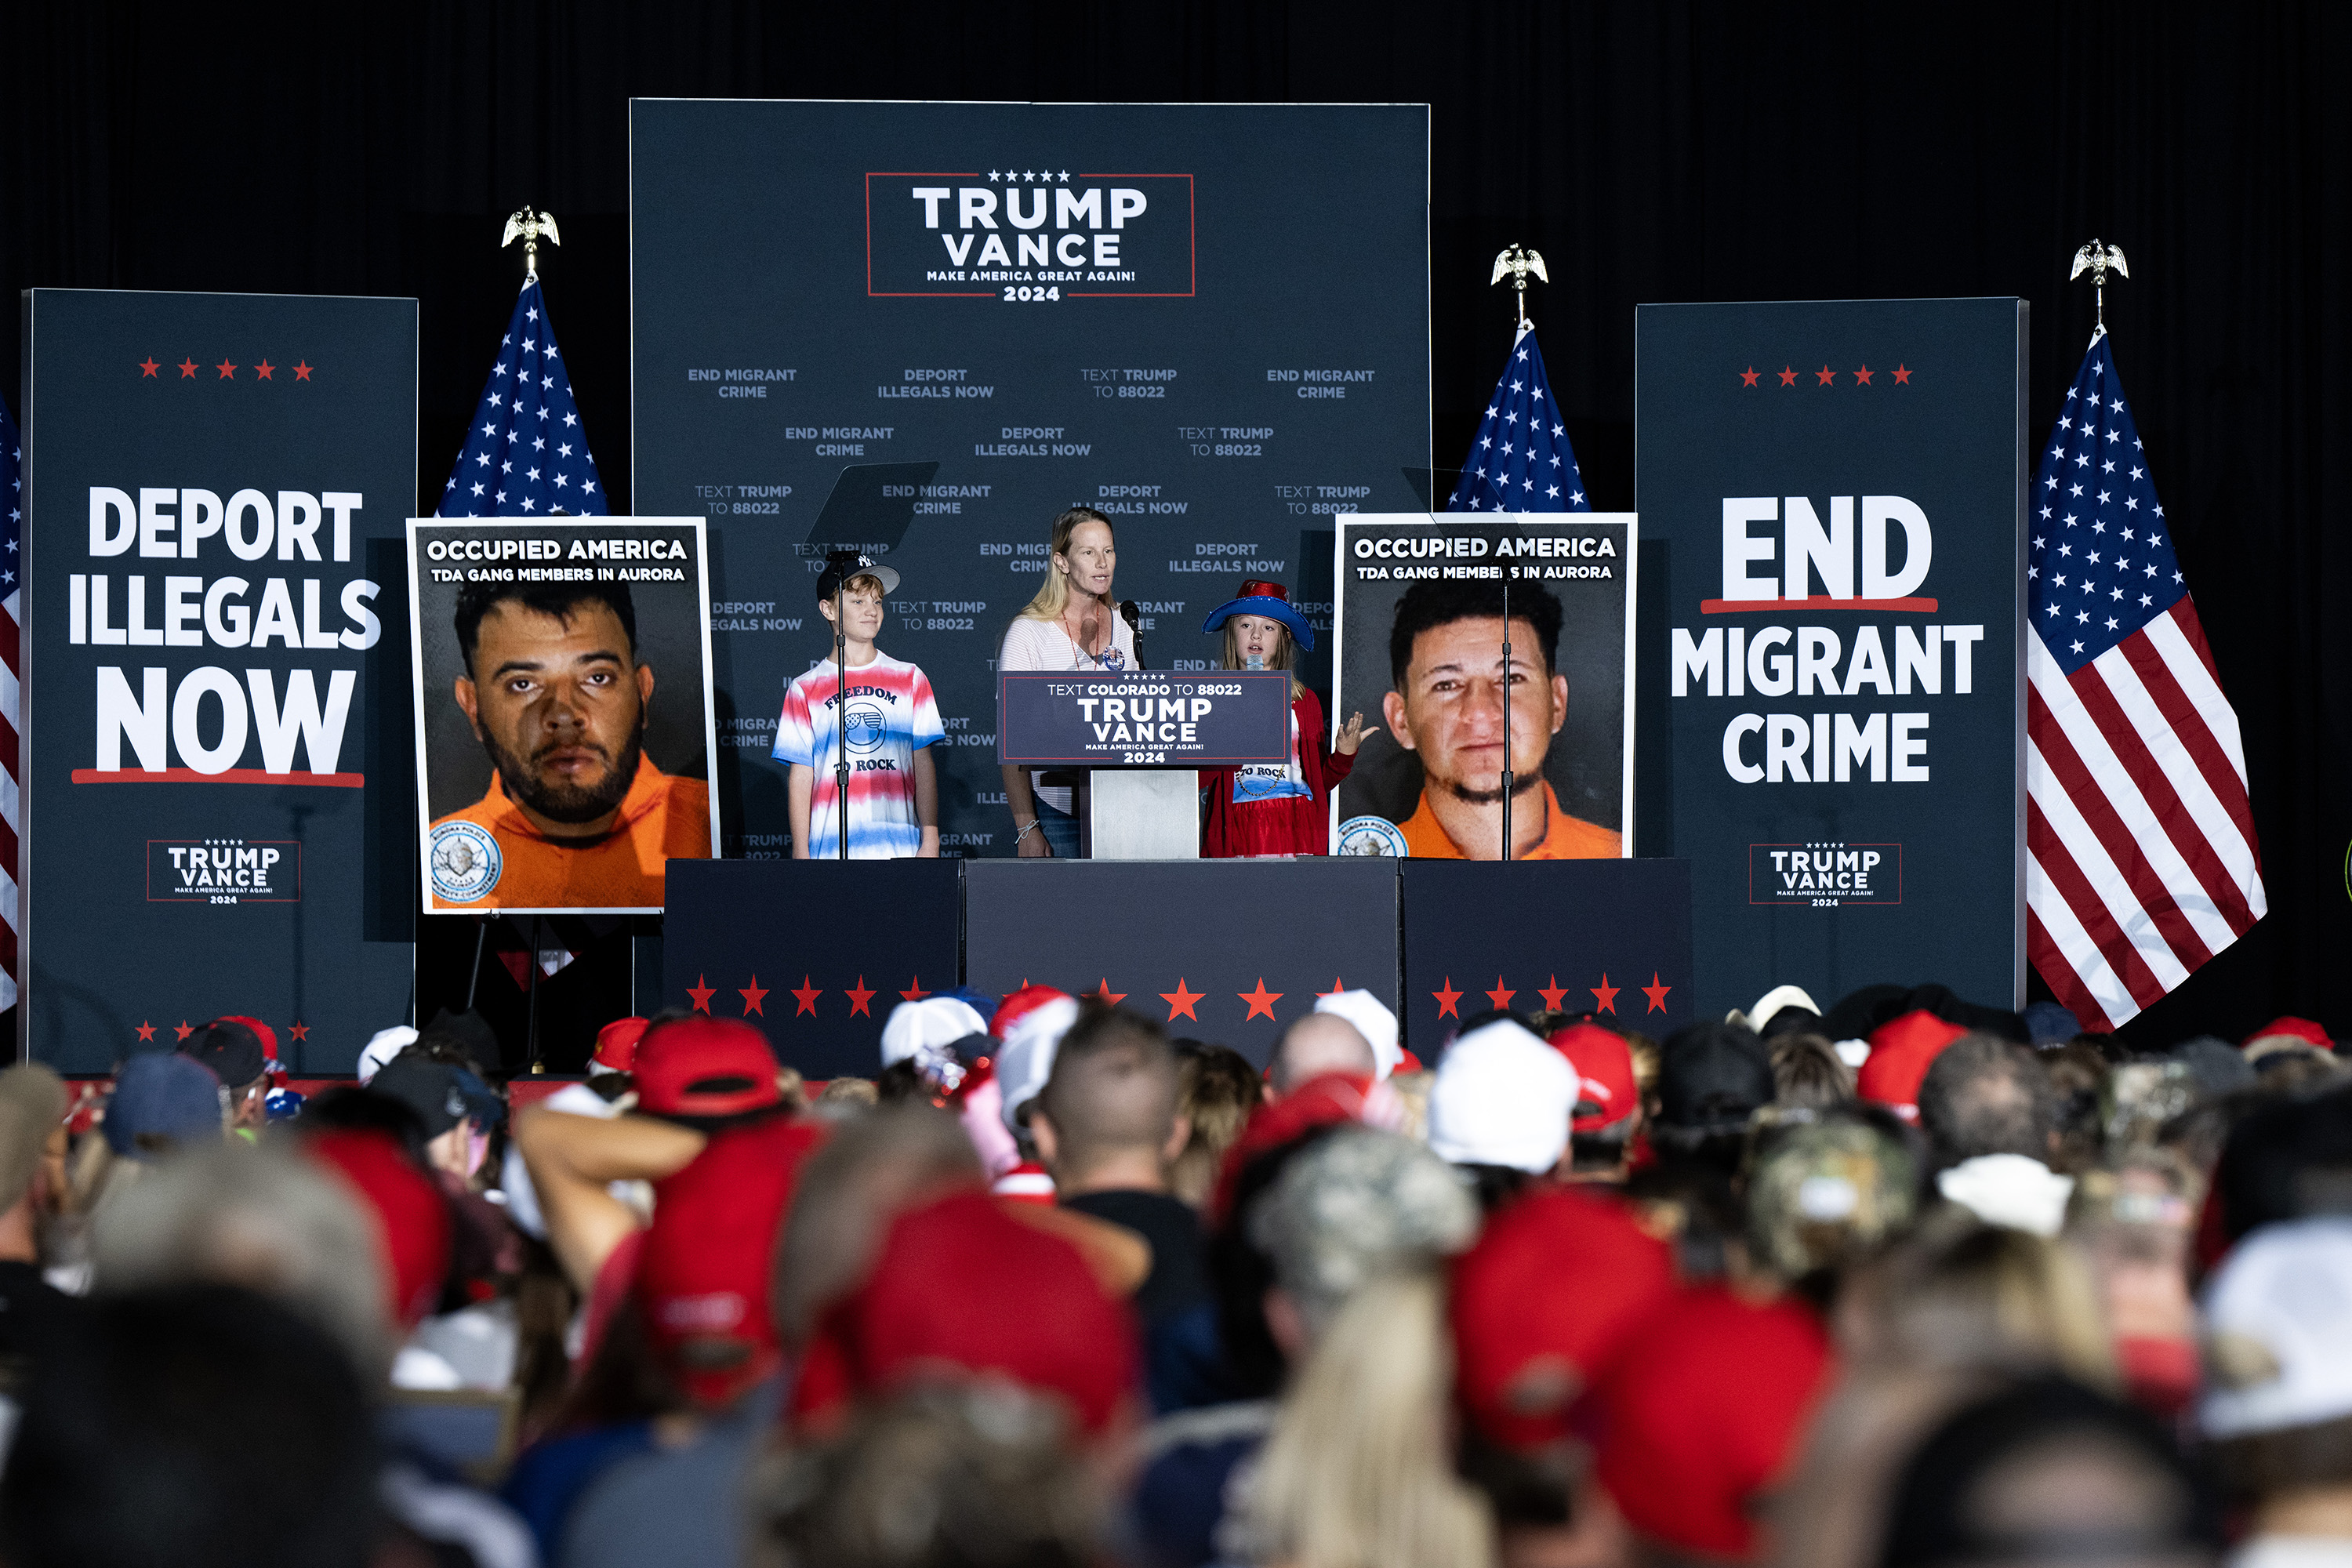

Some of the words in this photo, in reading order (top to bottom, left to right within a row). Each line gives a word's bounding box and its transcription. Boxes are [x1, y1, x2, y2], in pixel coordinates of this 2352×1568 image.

[913, 188, 1147, 229] TRUMP
[942, 234, 1120, 267] VANCE
[927, 271, 965, 281] MAKE
[971, 271, 1033, 281] AMERICA
[1038, 271, 1082, 281] GREAT
[1087, 271, 1134, 281] AGAIN!
[1004, 286, 1059, 301] 2024
[689, 369, 720, 380] END
[725, 369, 797, 381] MIGRANT
[905, 369, 967, 381] DEPORT
[1081, 369, 1119, 381] TEXT
[1123, 369, 1177, 380] TRUMP
[1268, 370, 1299, 381] END
[1304, 370, 1374, 381] MIGRANT
[719, 387, 766, 397] CRIME
[878, 387, 950, 397] ILLEGALS
[956, 387, 993, 397] NOW
[1093, 386, 1113, 397] TO
[1118, 387, 1164, 397] 88022
[1298, 387, 1345, 398] CRIME
[786, 428, 818, 439] END
[822, 427, 894, 439] MIGRANT
[1002, 427, 1064, 439] DEPORT
[1178, 427, 1215, 439] TEXT
[1221, 428, 1273, 439] TRUMP
[816, 445, 864, 456] CRIME
[975, 445, 1047, 456] ILLEGALS
[1053, 445, 1091, 456] NOW
[1190, 444, 1210, 456] TO
[1215, 445, 1261, 456] 88022
[695, 485, 733, 498] TEXT
[739, 486, 792, 497] TRUMP
[883, 485, 915, 496] END
[920, 485, 991, 497] MIGRANT
[1099, 485, 1161, 497] DEPORT
[1275, 486, 1312, 498] TEXT
[1317, 486, 1370, 498] TRUMP
[708, 503, 728, 514] TO
[733, 503, 779, 514] 88022
[913, 503, 961, 514] CRIME
[1149, 503, 1188, 514] NOW
[1287, 503, 1307, 514] TO
[1312, 503, 1358, 514] 88022
[89, 487, 362, 561] DEPORT
[427, 540, 561, 560] OCCUPIED
[568, 540, 687, 559] AMERICA
[793, 543, 830, 555] TEXT
[980, 544, 1012, 555] END
[1196, 544, 1258, 555] DEPORT
[1354, 539, 1488, 557] OCCUPIED
[1495, 538, 1616, 557] AMERICA
[1722, 495, 1932, 601] END
[805, 561, 826, 572] TO
[1011, 561, 1047, 572] CRIM
[1170, 561, 1241, 572] ILLEGALS
[1247, 561, 1284, 572] NOW
[1357, 567, 1388, 579] TDA
[1393, 567, 1439, 579] GANG
[1524, 567, 1540, 578] IN
[1544, 566, 1612, 578] AURORA
[431, 569, 463, 581] TDA
[468, 568, 514, 581] GANG
[518, 568, 593, 581] MEMBERS
[598, 568, 614, 580] IN
[618, 568, 684, 580] AURORA
[70, 574, 381, 650] ILLEGALS
[713, 602, 775, 614] DEPORT
[890, 601, 927, 613] TEXT
[932, 602, 986, 613] TRUMP
[1293, 602, 1333, 614] DEPO
[710, 619, 759, 630] EGALS
[764, 619, 802, 630] NOW
[902, 619, 922, 630] TO
[927, 619, 974, 630] 88022
[1174, 659, 1206, 670] END
[1672, 625, 1984, 696] MIGRANT
[1047, 684, 1083, 695] TEXT
[1088, 684, 1170, 695] COLORADO
[1174, 684, 1193, 695] TO
[1198, 684, 1241, 695] 88022
[1077, 699, 1212, 721] TRUMP
[96, 666, 357, 775] NOW
[728, 718, 779, 730] MIGRA
[1093, 723, 1196, 742] VANCE
[720, 735, 769, 746] CRIME
[957, 735, 996, 746] NOW
[1723, 713, 1929, 783] CRIME
[1124, 752, 1165, 763] 2024
[856, 759, 897, 771] ROCK
[1240, 768, 1254, 776] TO
[1258, 767, 1286, 779] ROCK
[977, 793, 1008, 804] ILLE
[940, 834, 993, 845] GRANT
[168, 848, 280, 869] TRUMP
[1770, 851, 1880, 872] TRUMP
[181, 868, 268, 886] VANCE
[1783, 871, 1867, 888] VANCE
